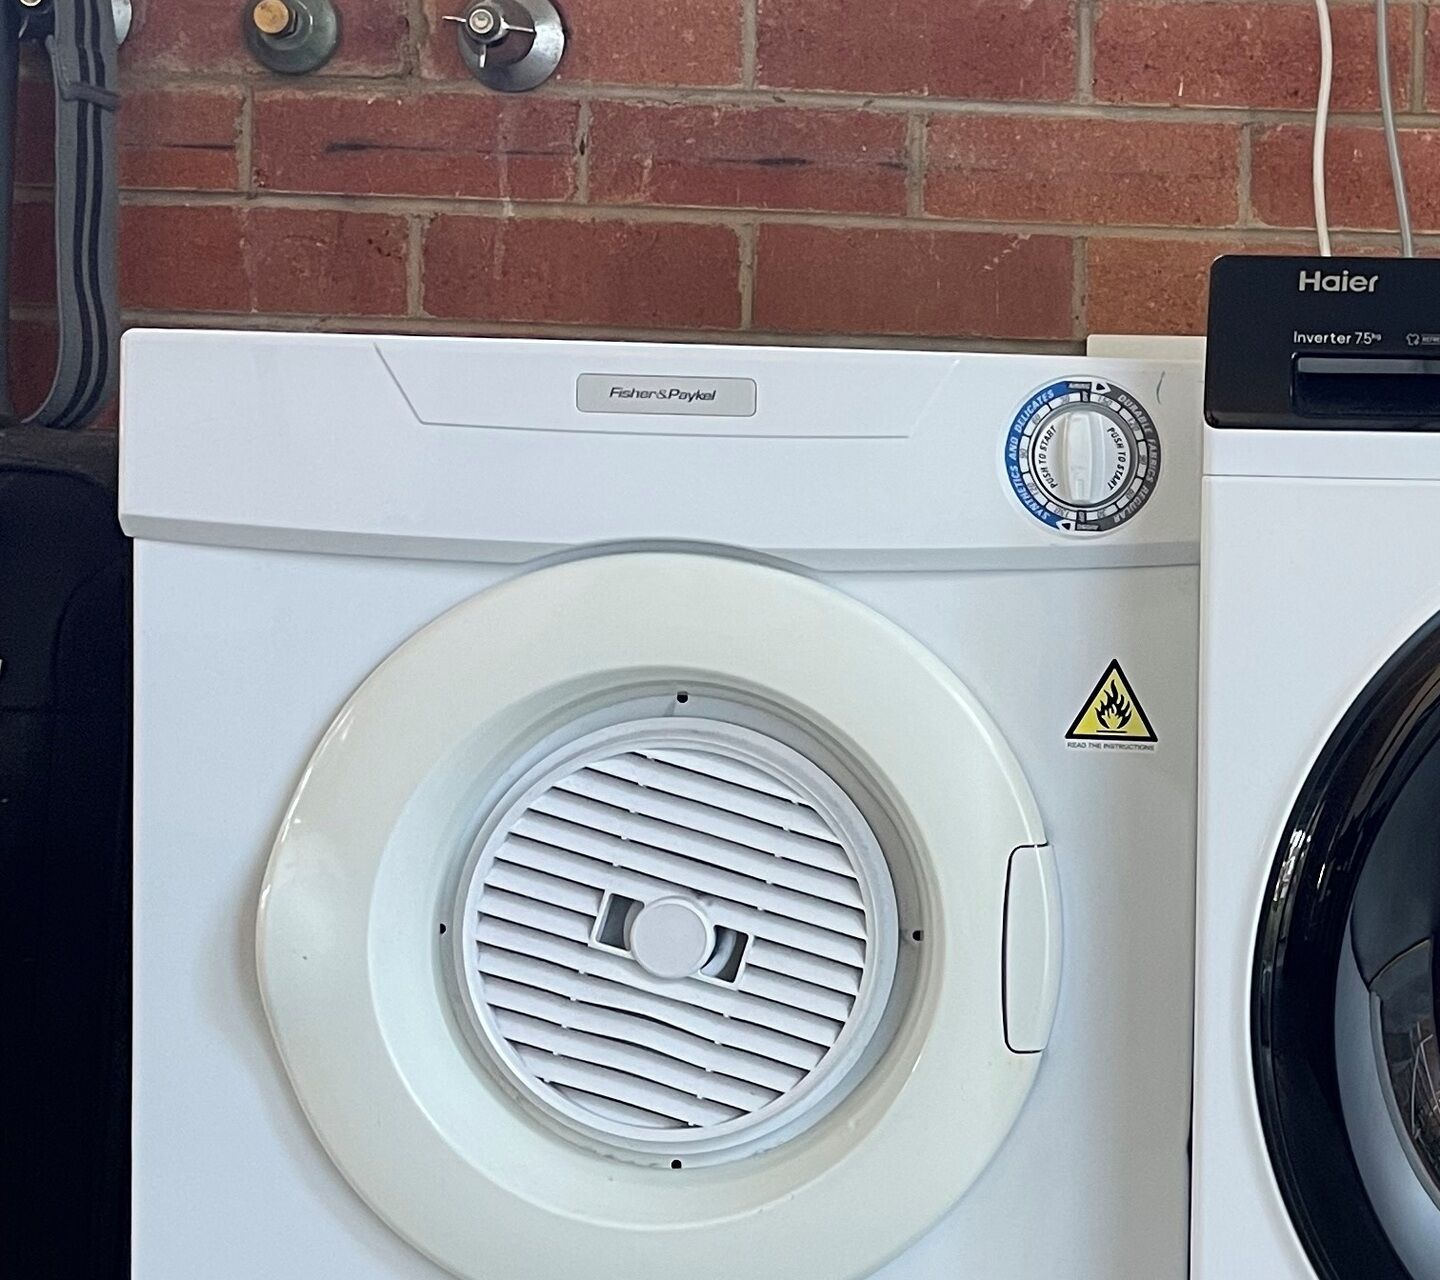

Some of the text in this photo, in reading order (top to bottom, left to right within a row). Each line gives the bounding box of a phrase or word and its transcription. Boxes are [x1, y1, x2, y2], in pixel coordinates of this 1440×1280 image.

[1298, 270, 1379, 292] Haier
[1293, 331, 1352, 344] Inverter
[1008, 389, 1055, 521] SYNTHETICS AND DELICATES
[1039, 424, 1059, 489] PUSH TO START
[1107, 427, 1126, 491] PUSH TO START
